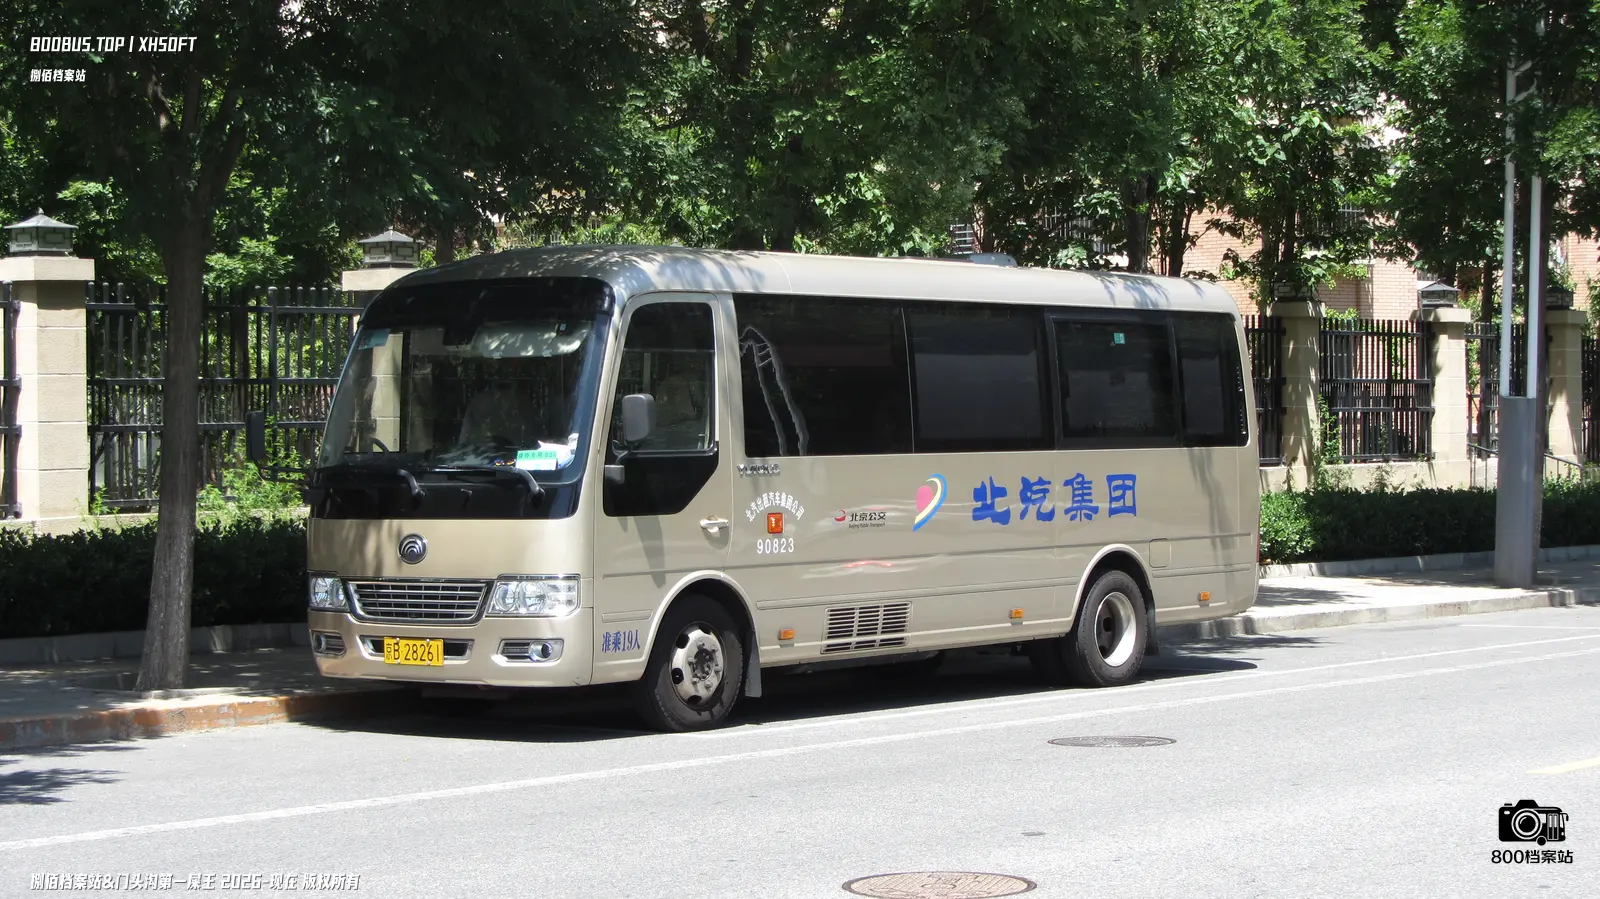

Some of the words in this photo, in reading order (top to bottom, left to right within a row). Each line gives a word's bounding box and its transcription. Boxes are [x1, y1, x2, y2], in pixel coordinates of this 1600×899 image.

[972, 472, 1137, 526] 北汽集团
[849, 511, 886, 522] 北京公交
[757, 538, 794, 554] 90823
[601, 630, 641, 653] 准乘19人
